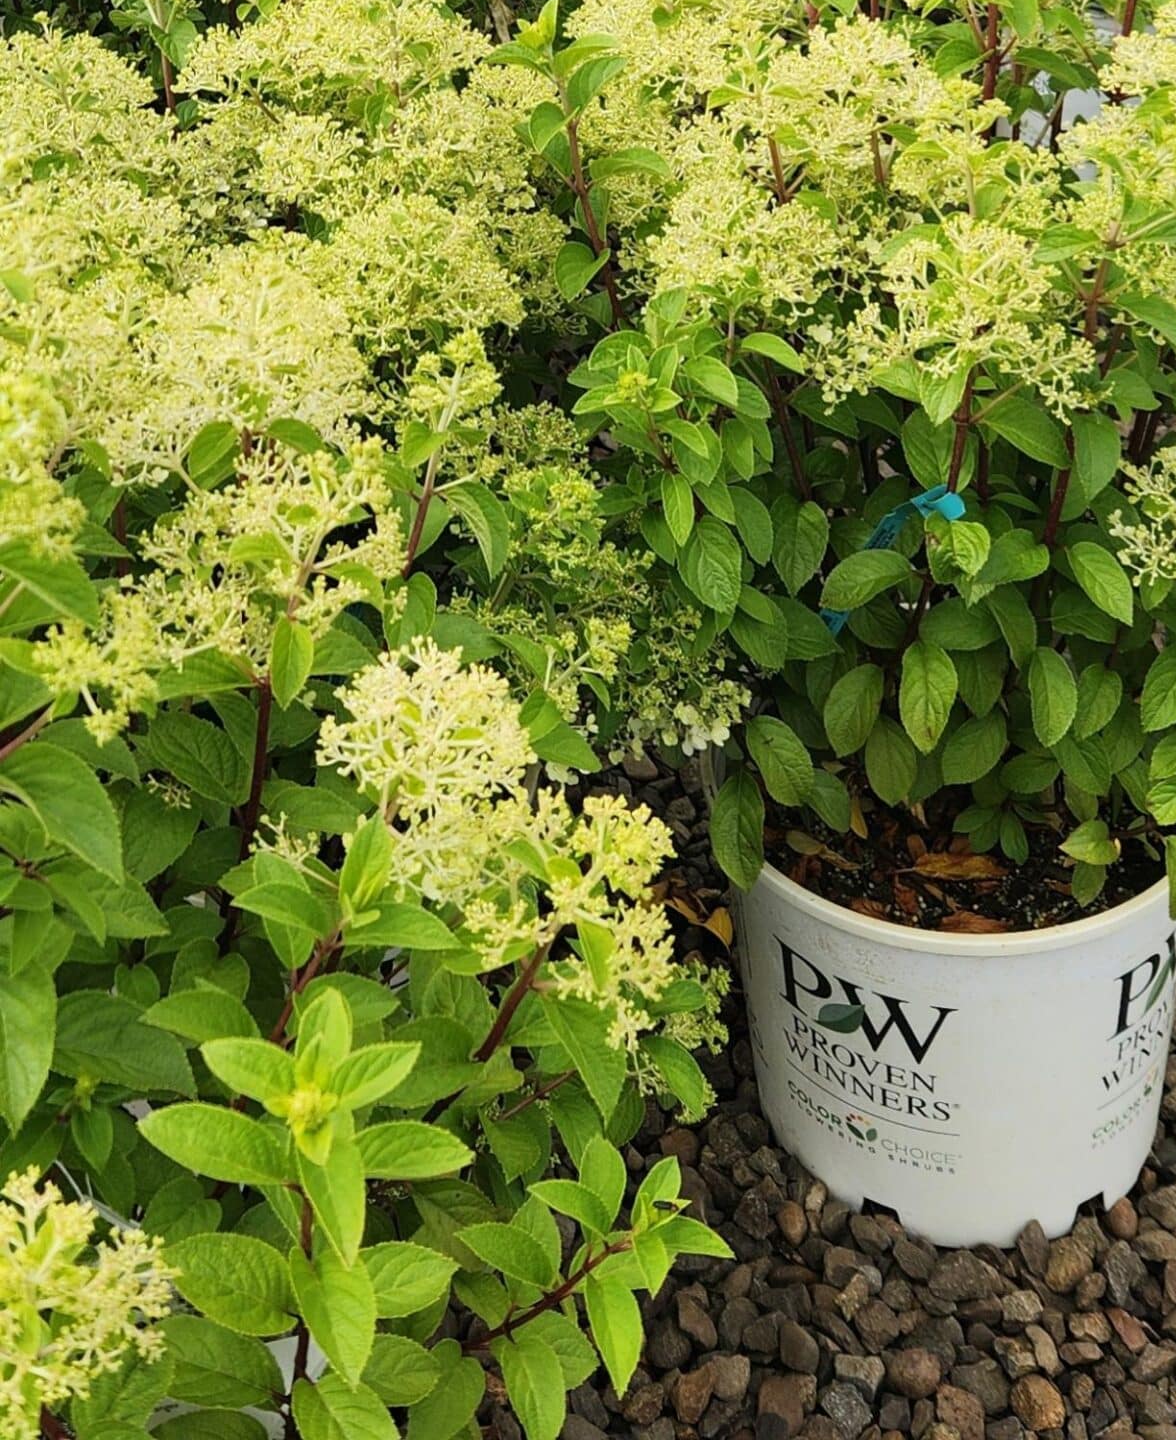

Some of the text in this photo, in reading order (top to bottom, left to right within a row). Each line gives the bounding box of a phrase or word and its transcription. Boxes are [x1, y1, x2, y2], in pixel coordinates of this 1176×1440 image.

[770, 934, 960, 1064] PW
[791, 1012, 936, 1094] PROVEN
[787, 1079, 957, 1166] COLOR CHOICE
[887, 1154, 957, 1175] SHRUBS
